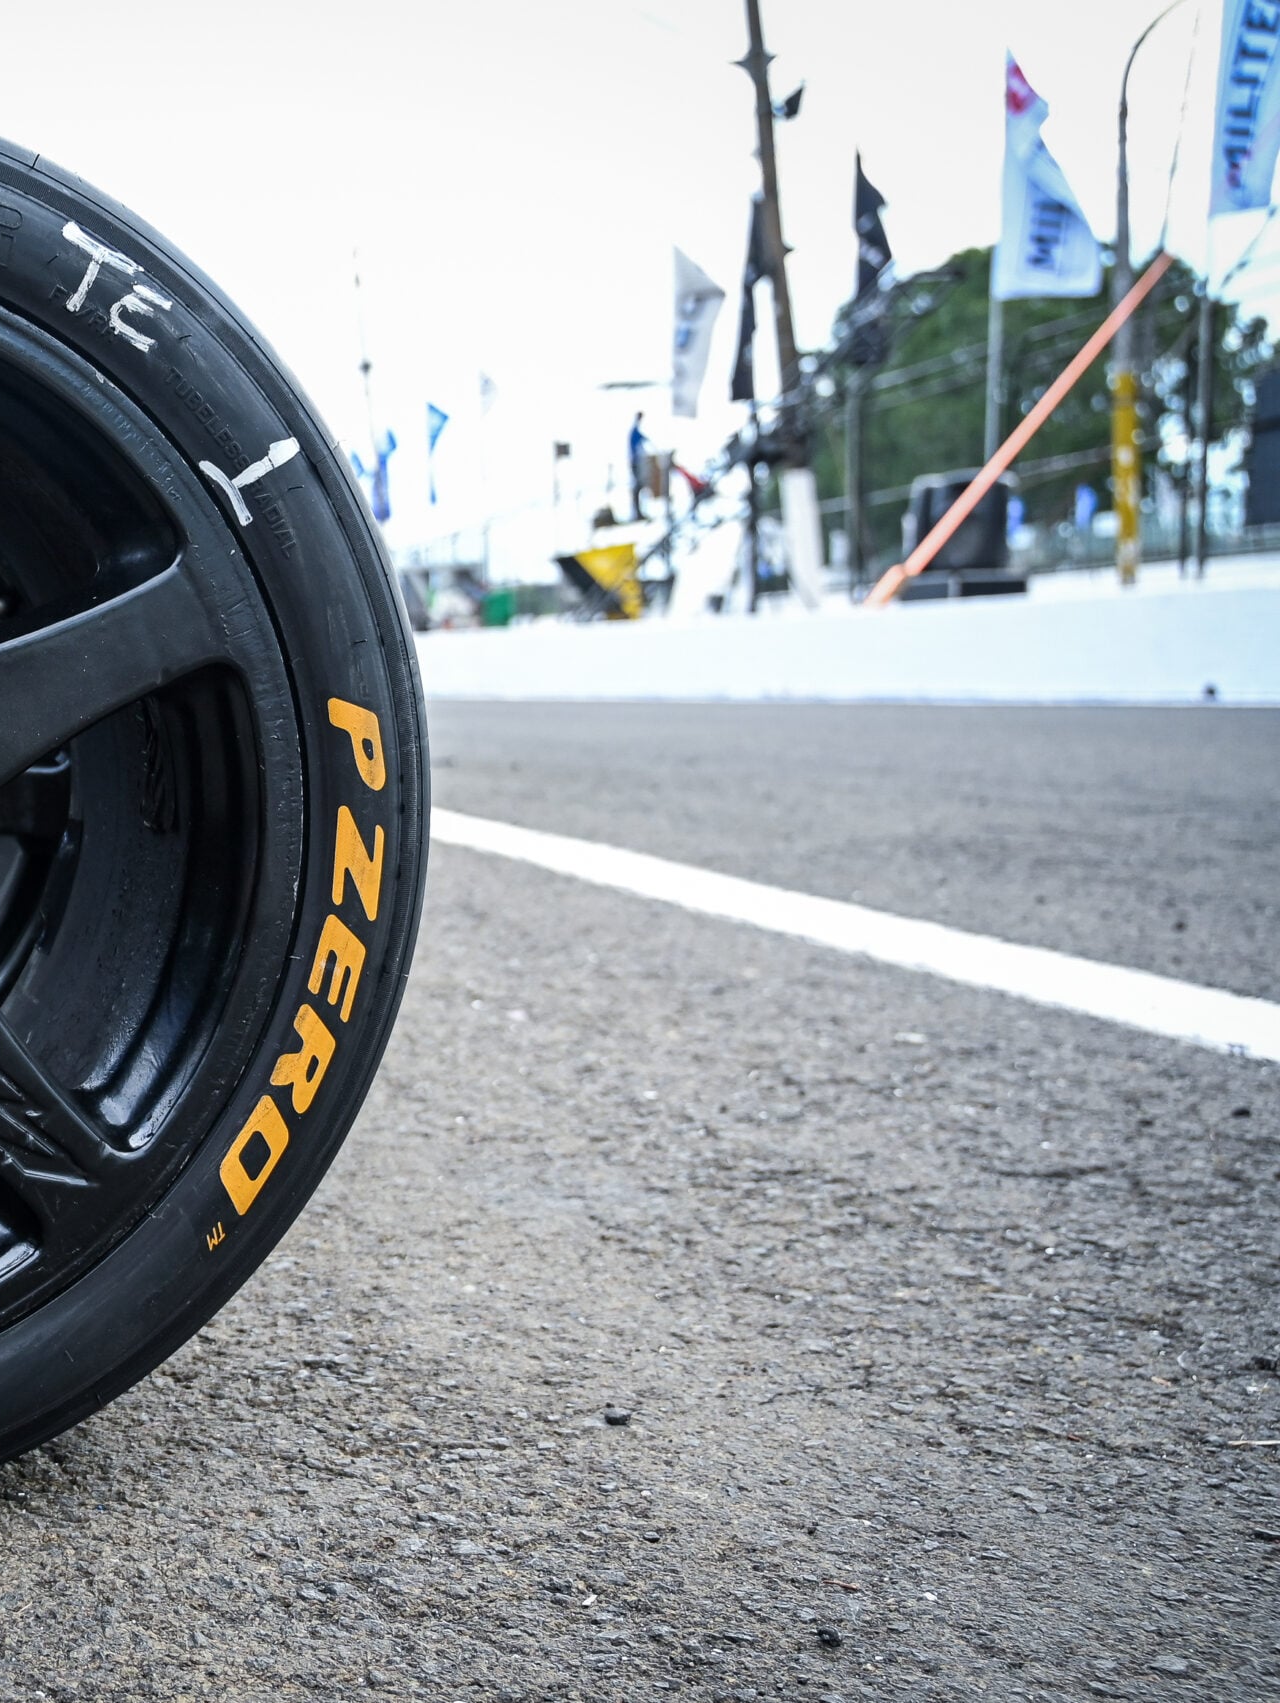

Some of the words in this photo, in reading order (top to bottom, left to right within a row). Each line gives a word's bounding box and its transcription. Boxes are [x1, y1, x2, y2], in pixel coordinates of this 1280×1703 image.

[1224, 0, 1280, 190] MILITE
[61, 220, 173, 353] TE
[163, 365, 252, 475] TUBELESS
